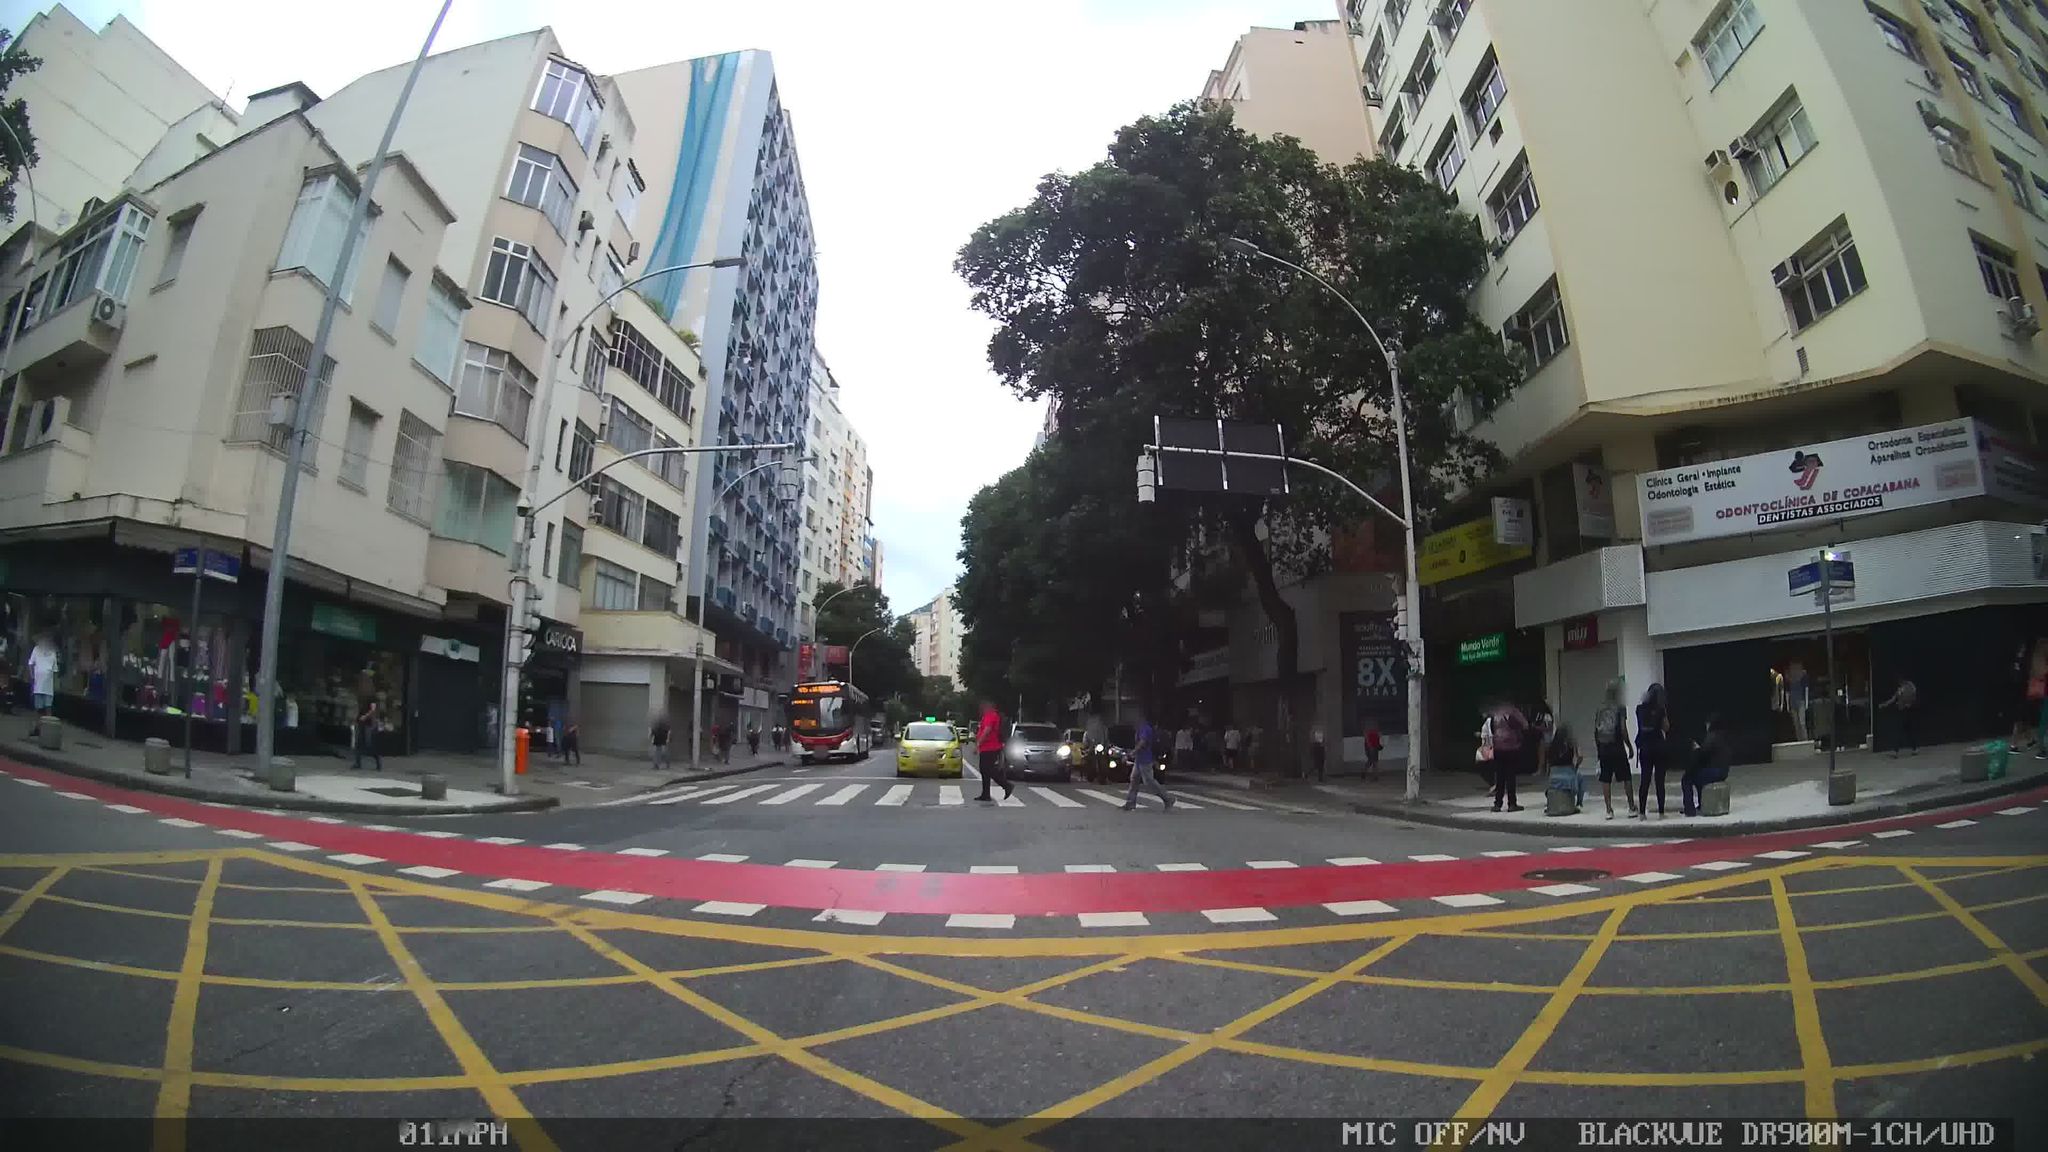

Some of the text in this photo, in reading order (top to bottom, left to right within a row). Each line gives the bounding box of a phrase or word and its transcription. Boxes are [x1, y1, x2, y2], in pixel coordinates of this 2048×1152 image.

[1677, 469, 1700, 483] Geral
[1823, 490, 1839, 502] DE
[1843, 477, 1921, 499] COPACABANA
[1758, 496, 1881, 525] DENTISTAS ASSOCIADOS
[1357, 657, 1397, 688] 8X
